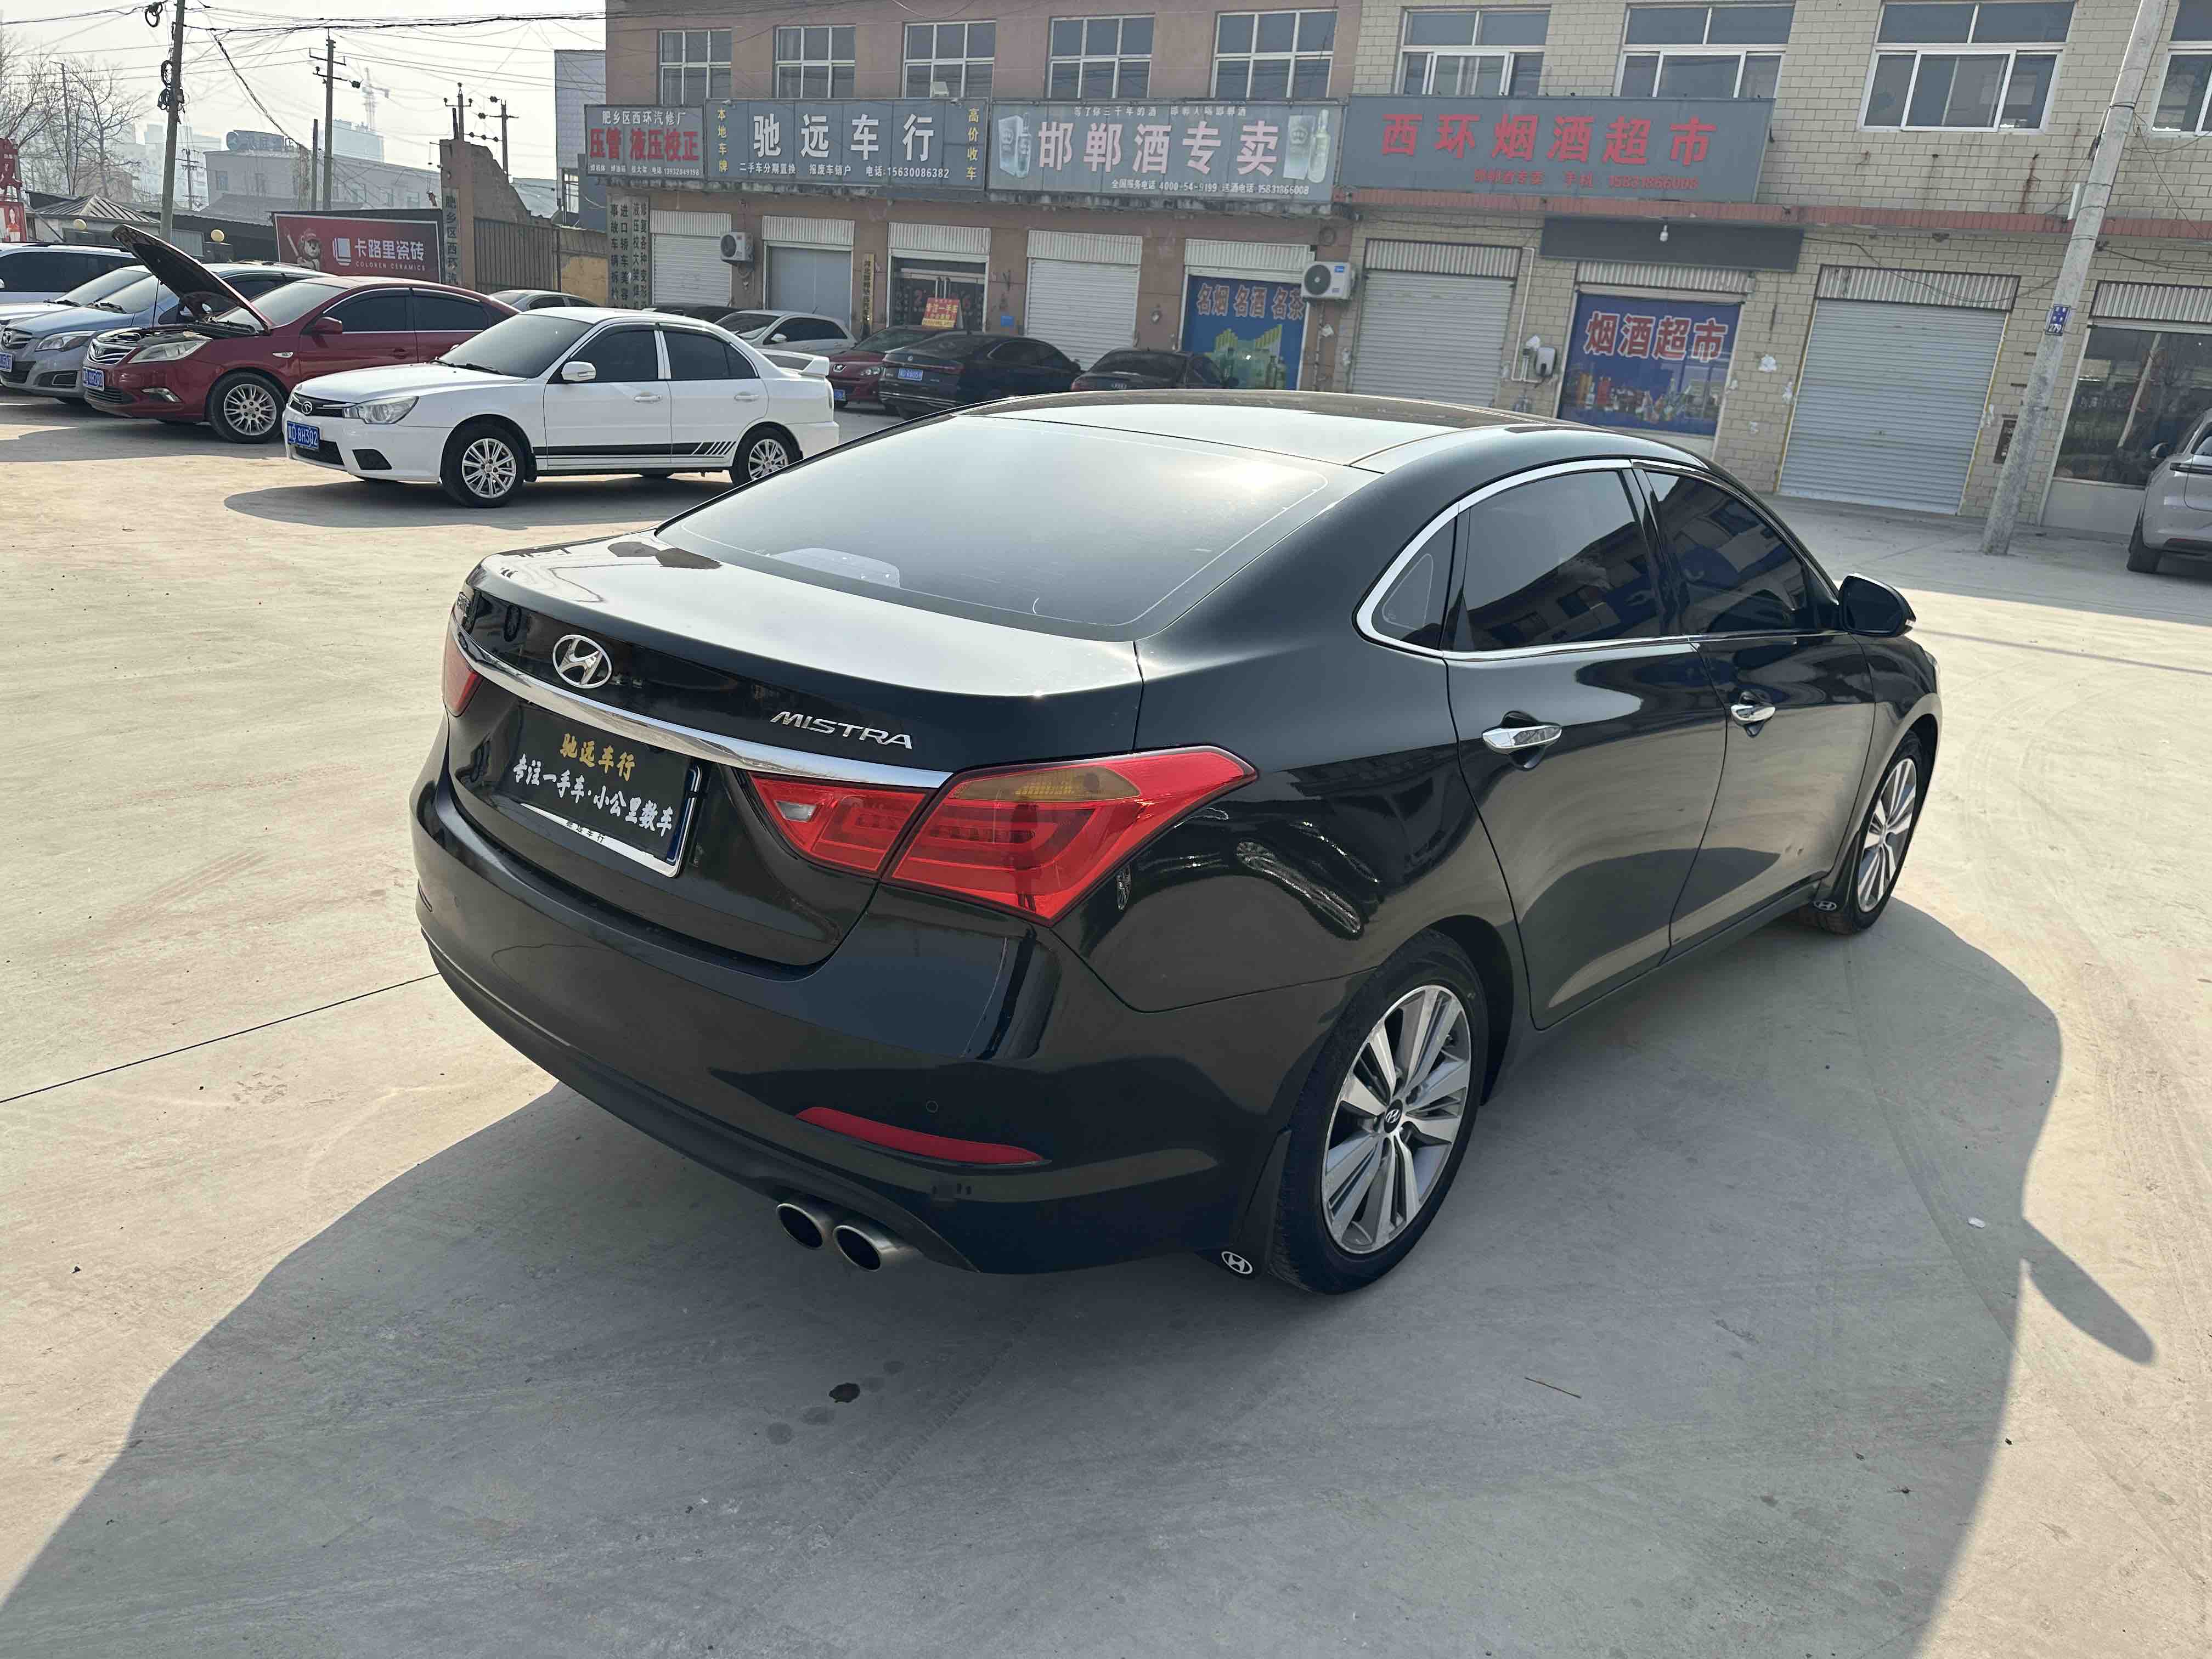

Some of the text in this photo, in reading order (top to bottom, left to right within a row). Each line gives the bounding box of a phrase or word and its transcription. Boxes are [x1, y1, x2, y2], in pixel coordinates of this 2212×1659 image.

[602, 111, 686, 126] 肥乡区西环汽修厂
[718, 108, 728, 172] 本地车牌
[754, 113, 934, 161] 驰远车行
[1382, 114, 1717, 167] 西环烟酒超市
[630, 127, 699, 161] 液压校正
[966, 108, 979, 180] 高价收车
[1039, 121, 1278, 176] 邯郸酒专卖
[740, 162, 796, 174] 二手车分期置换
[809, 164, 851, 176] 报废车销户
[355, 238, 425, 261] 卡路里瓷砖
[1197, 283, 1305, 320] 名烟 名酒 名茶
[1583, 311, 1728, 362] 烟酒超市
[770, 711, 913, 749] MISTRA
[560, 733, 635, 781] 驰远车行
